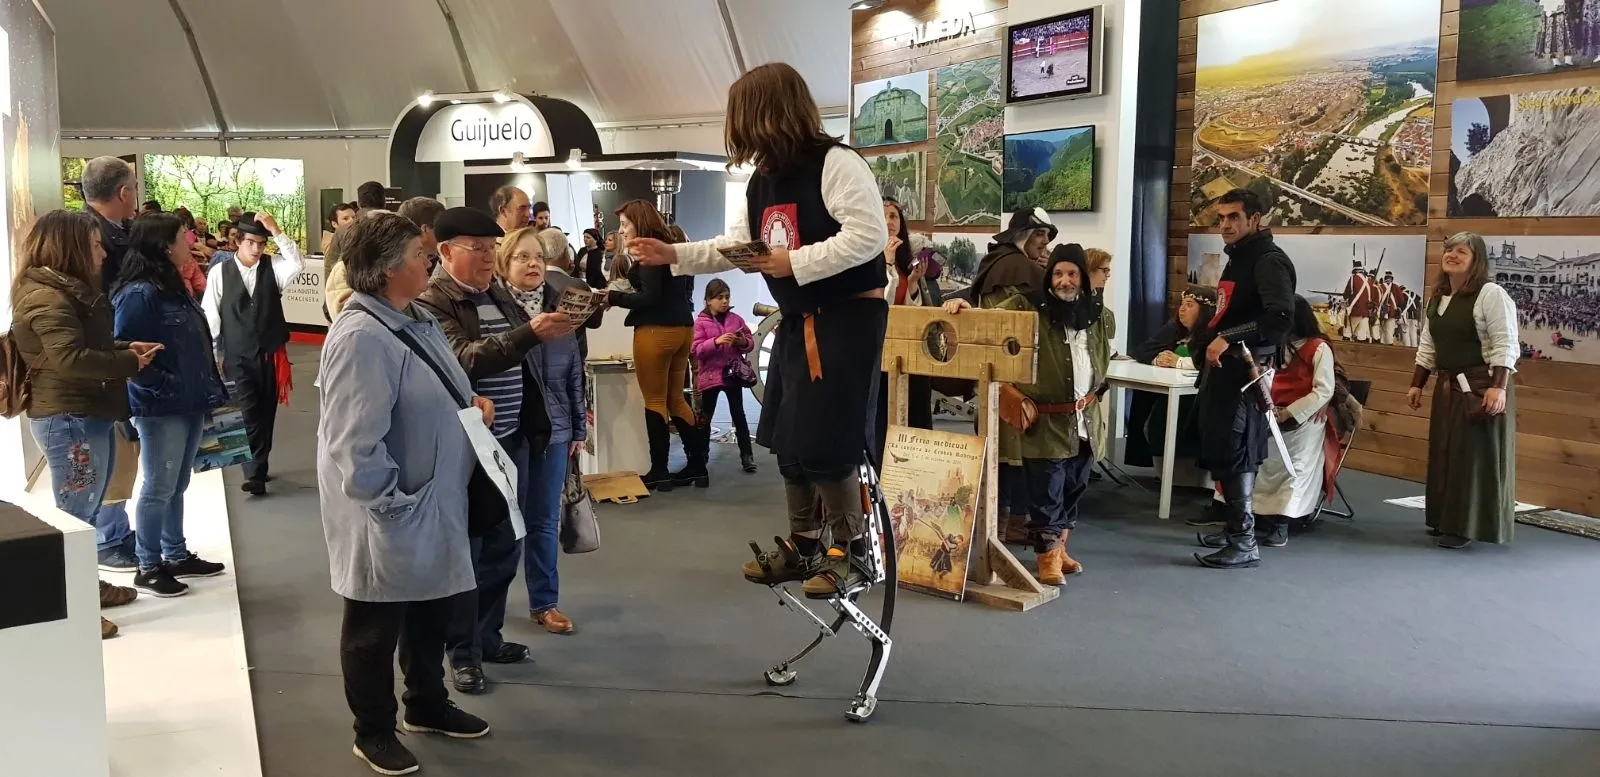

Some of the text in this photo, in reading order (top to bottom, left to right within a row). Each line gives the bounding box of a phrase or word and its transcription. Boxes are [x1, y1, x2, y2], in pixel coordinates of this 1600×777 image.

[451, 116, 532, 147] Guijuelo
[898, 433, 908, 443] III
[933, 440, 968, 450] medieval
